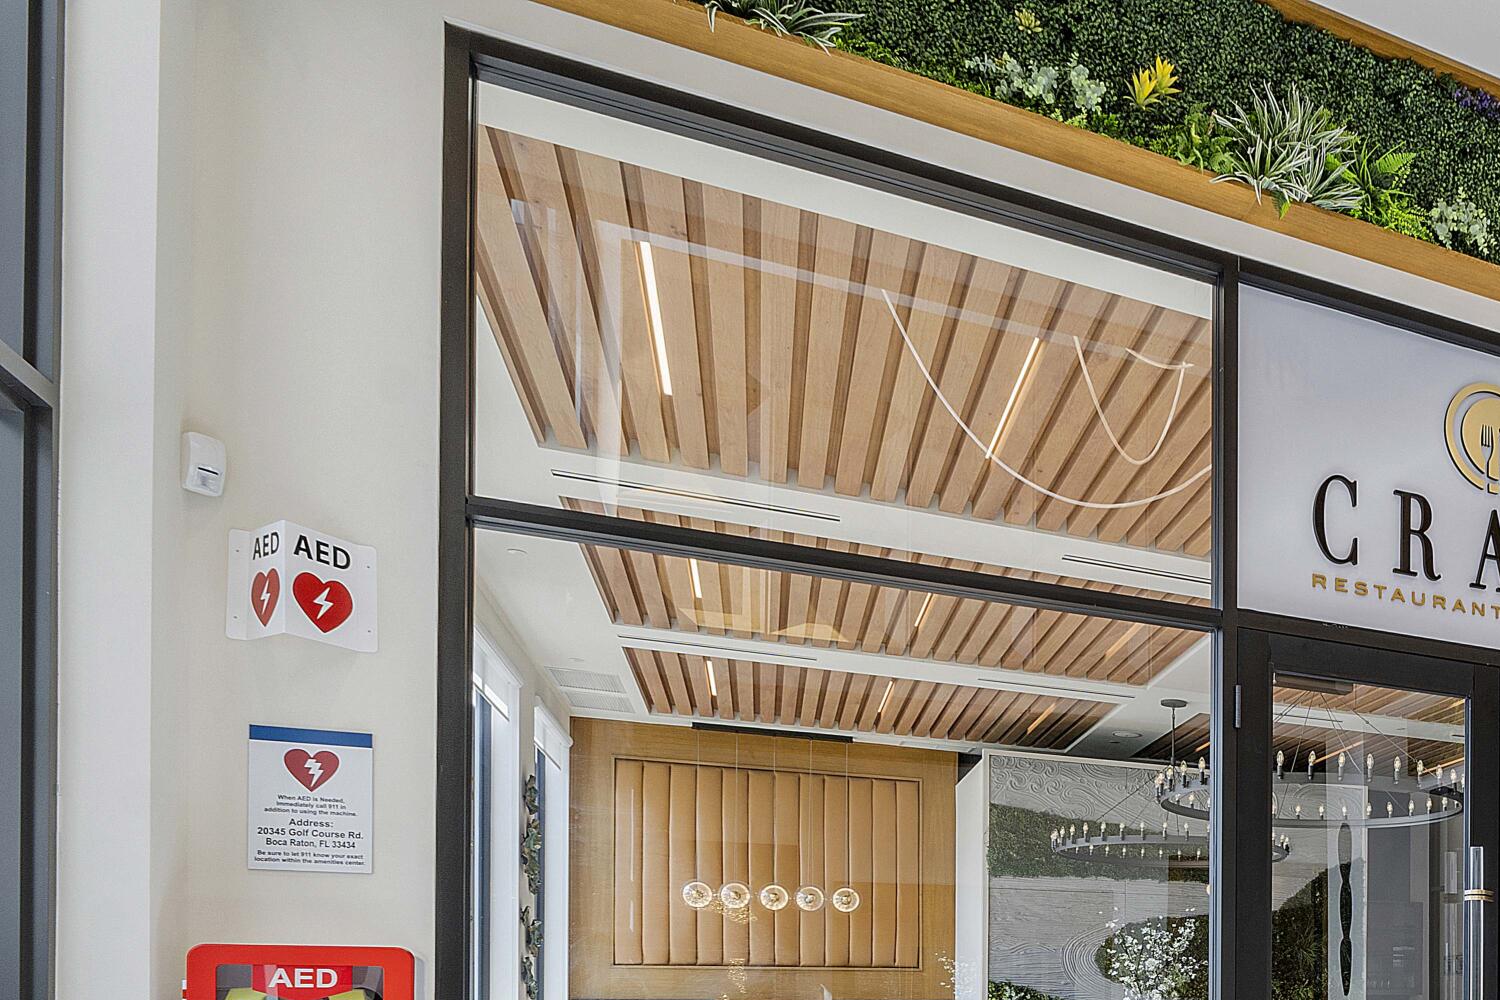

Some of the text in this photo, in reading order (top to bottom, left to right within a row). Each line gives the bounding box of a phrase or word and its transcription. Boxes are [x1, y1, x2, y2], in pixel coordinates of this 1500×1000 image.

[252, 531, 280, 561] AED
[293, 534, 351, 570] AED
[289, 818, 334, 828] Address:
[257, 826, 364, 839] 20345 Golf Course Rd.
[265, 837, 356, 849] Boca Raton, FL 33434
[268, 967, 338, 989] AED
